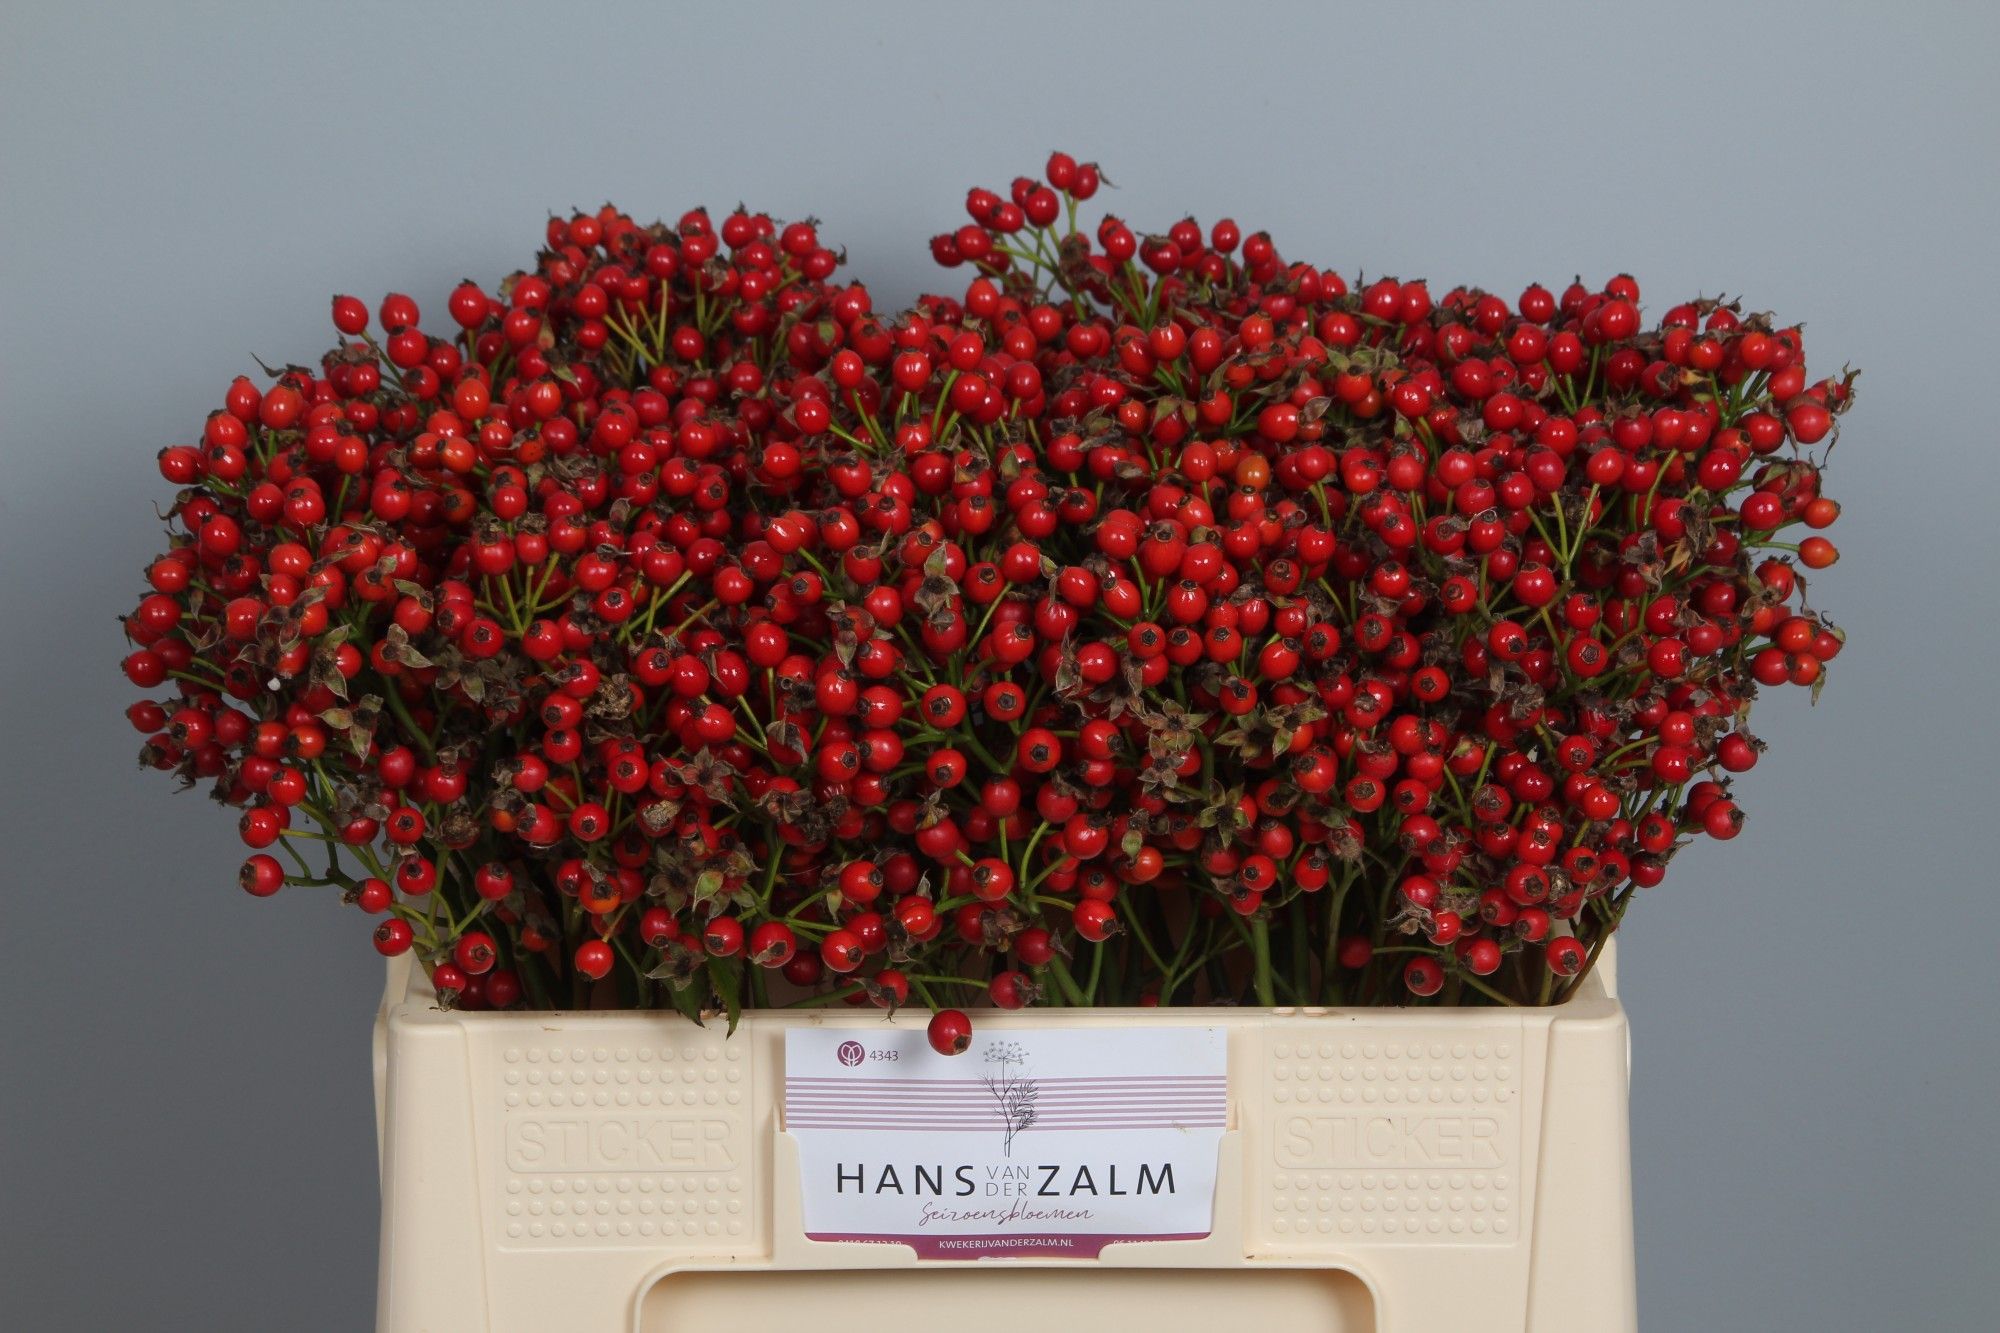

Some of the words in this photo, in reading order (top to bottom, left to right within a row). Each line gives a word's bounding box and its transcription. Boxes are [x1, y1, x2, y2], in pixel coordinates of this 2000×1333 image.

[869, 1050, 899, 1061] 4343
[516, 1120, 735, 1167] STICKER
[1285, 1116, 1504, 1163] STICKER
[837, 1163, 976, 1196] HANS
[986, 1165, 1030, 1180] VAN
[1037, 1163, 1176, 1197] ZALM
[986, 1182, 1028, 1197] DER
[918, 1197, 1094, 1227] Seizoensbloemen
[939, 1238, 1074, 1249] KWEKERIJVANDERZALM.NL
